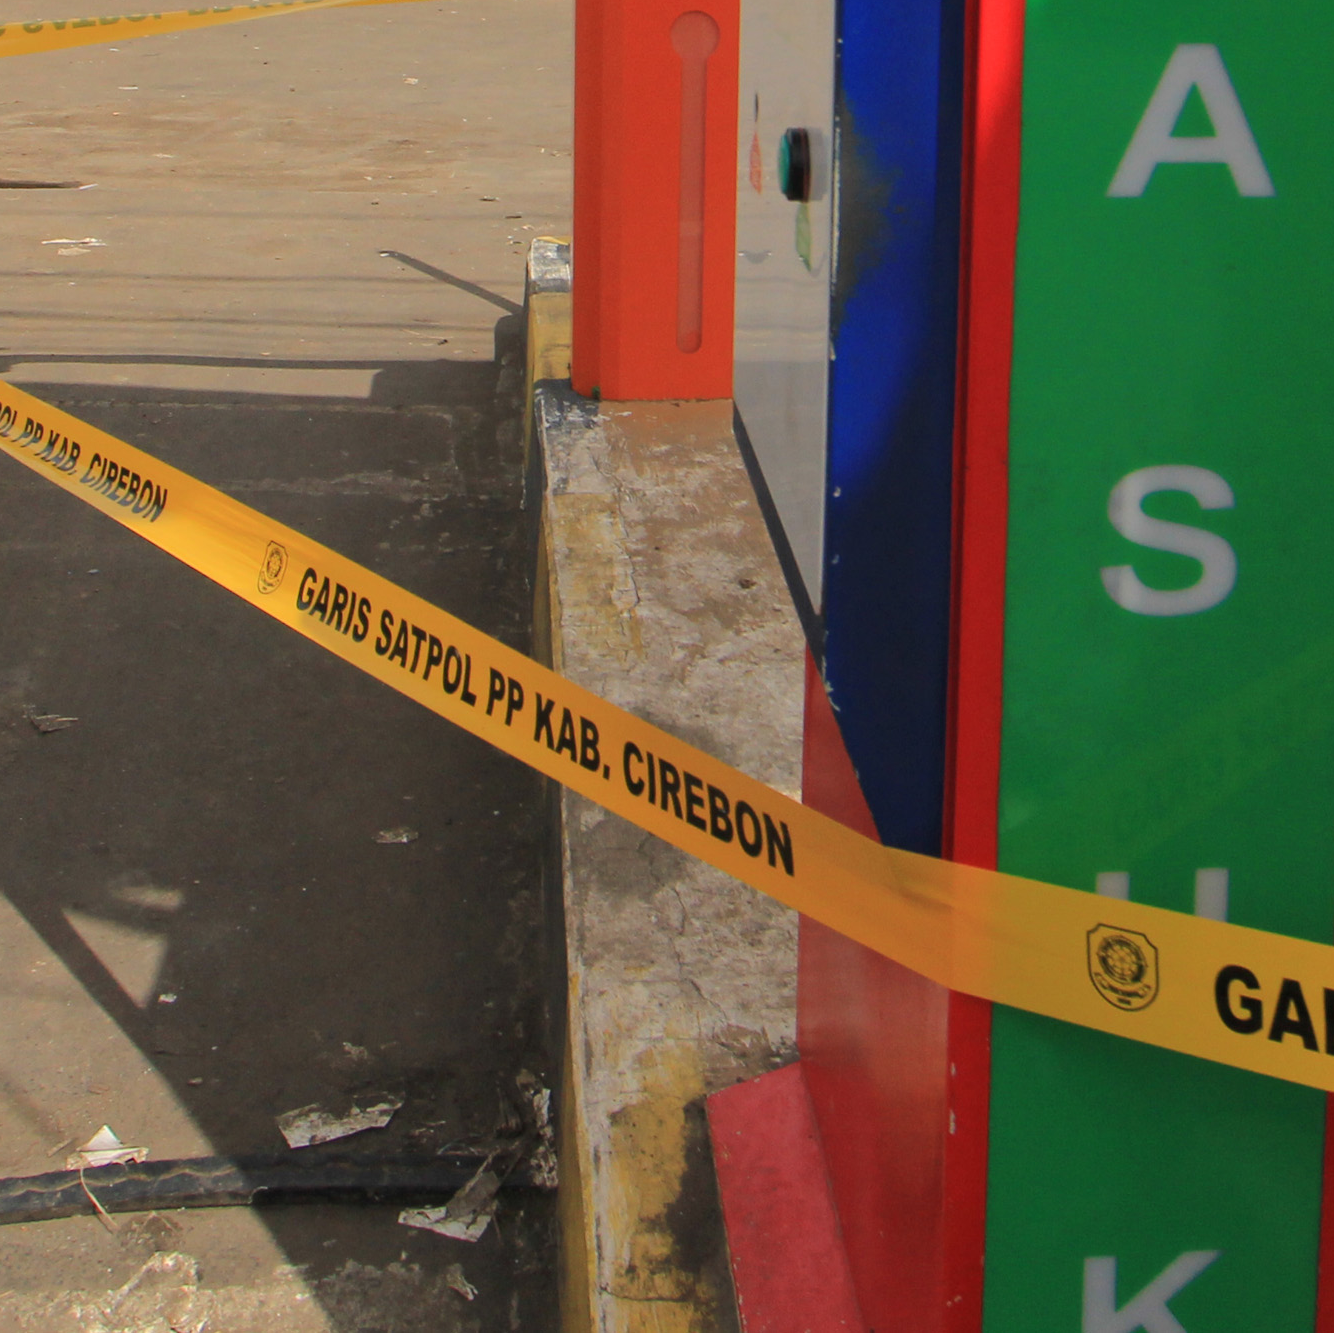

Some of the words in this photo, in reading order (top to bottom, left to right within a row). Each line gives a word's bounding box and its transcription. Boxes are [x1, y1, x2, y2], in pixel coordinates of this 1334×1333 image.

[11, 417, 44, 448] PP
[79, 453, 167, 523] CIREBON
[296, 567, 371, 643] GARIS
[375, 609, 477, 707] SATPOL
[485, 666, 524, 727] PP
[533, 692, 610, 781] KAB.
[623, 741, 795, 877] CIREBON
